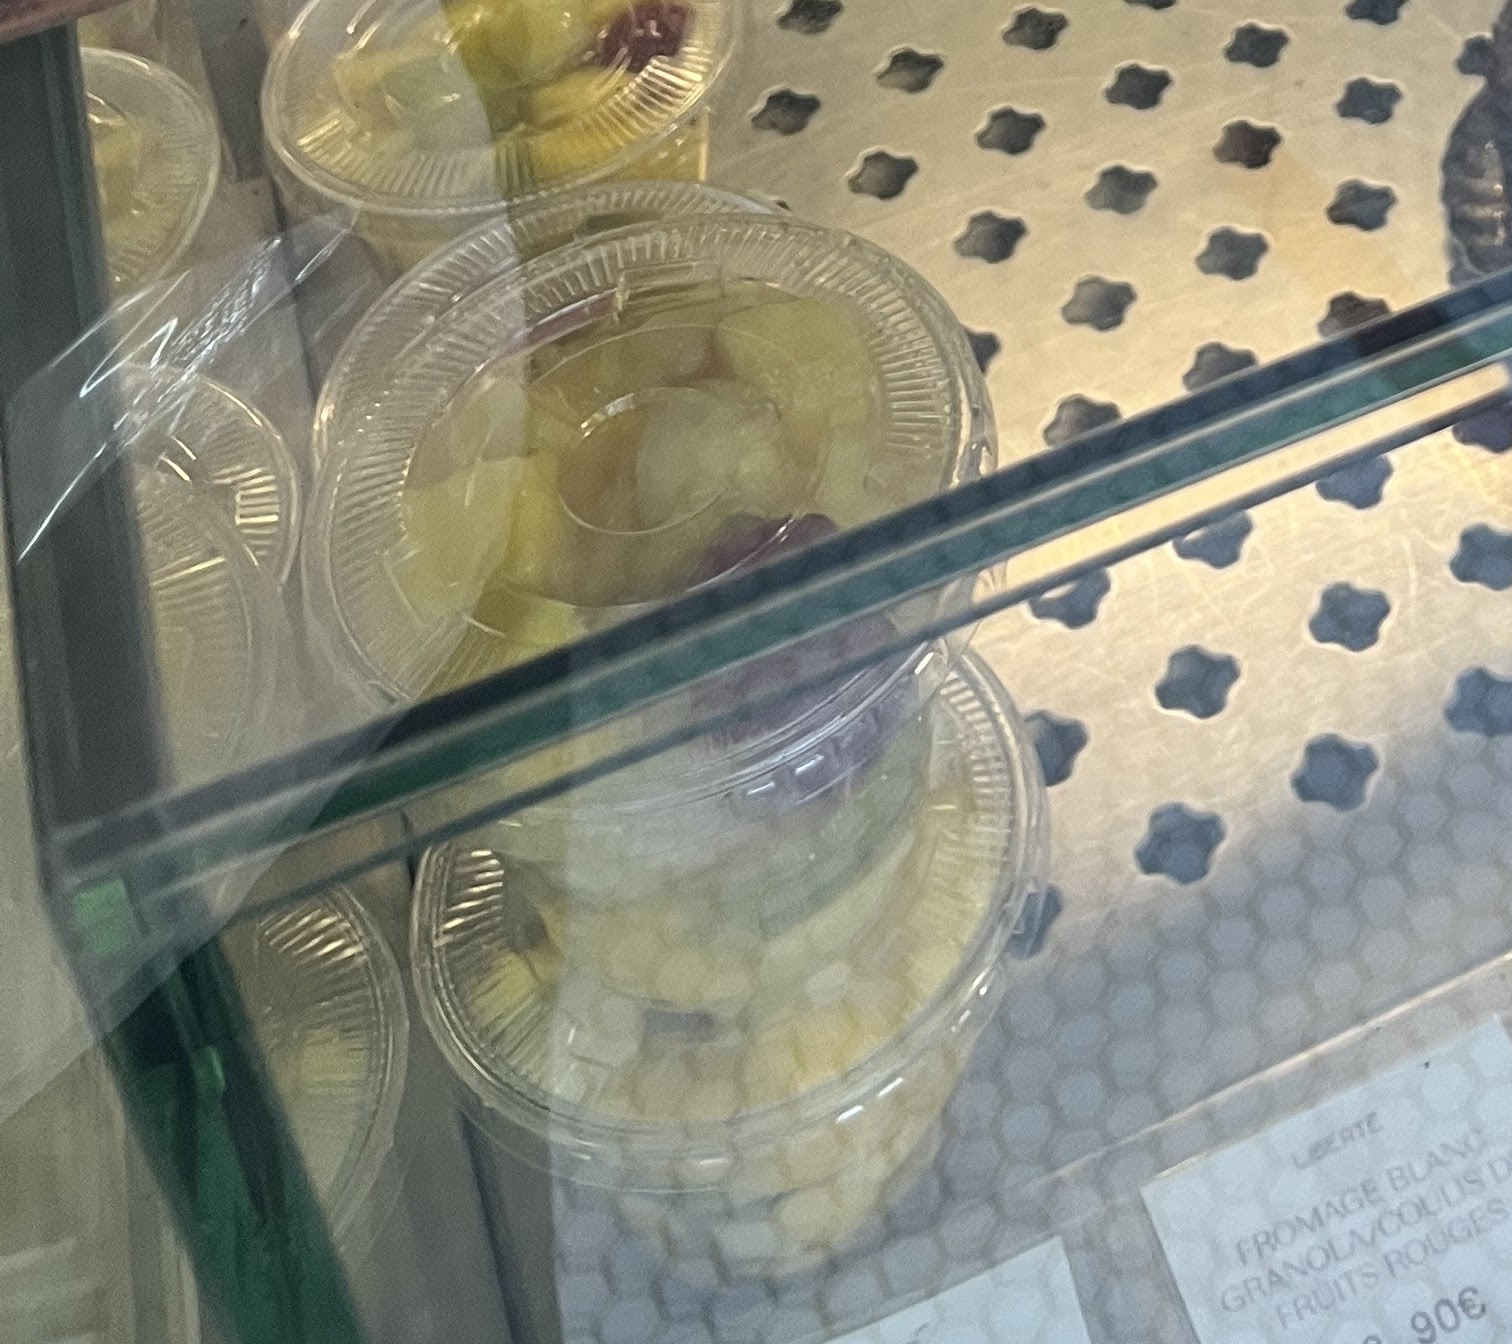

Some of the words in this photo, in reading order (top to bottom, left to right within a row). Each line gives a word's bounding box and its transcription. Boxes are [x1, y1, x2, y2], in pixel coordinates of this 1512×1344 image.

[1235, 1177, 1385, 1266] FROMAGE
[1386, 1125, 1488, 1192] BLANC
[1274, 1263, 1380, 1330] FRUITS
[1382, 1196, 1511, 1279] ROUGES
